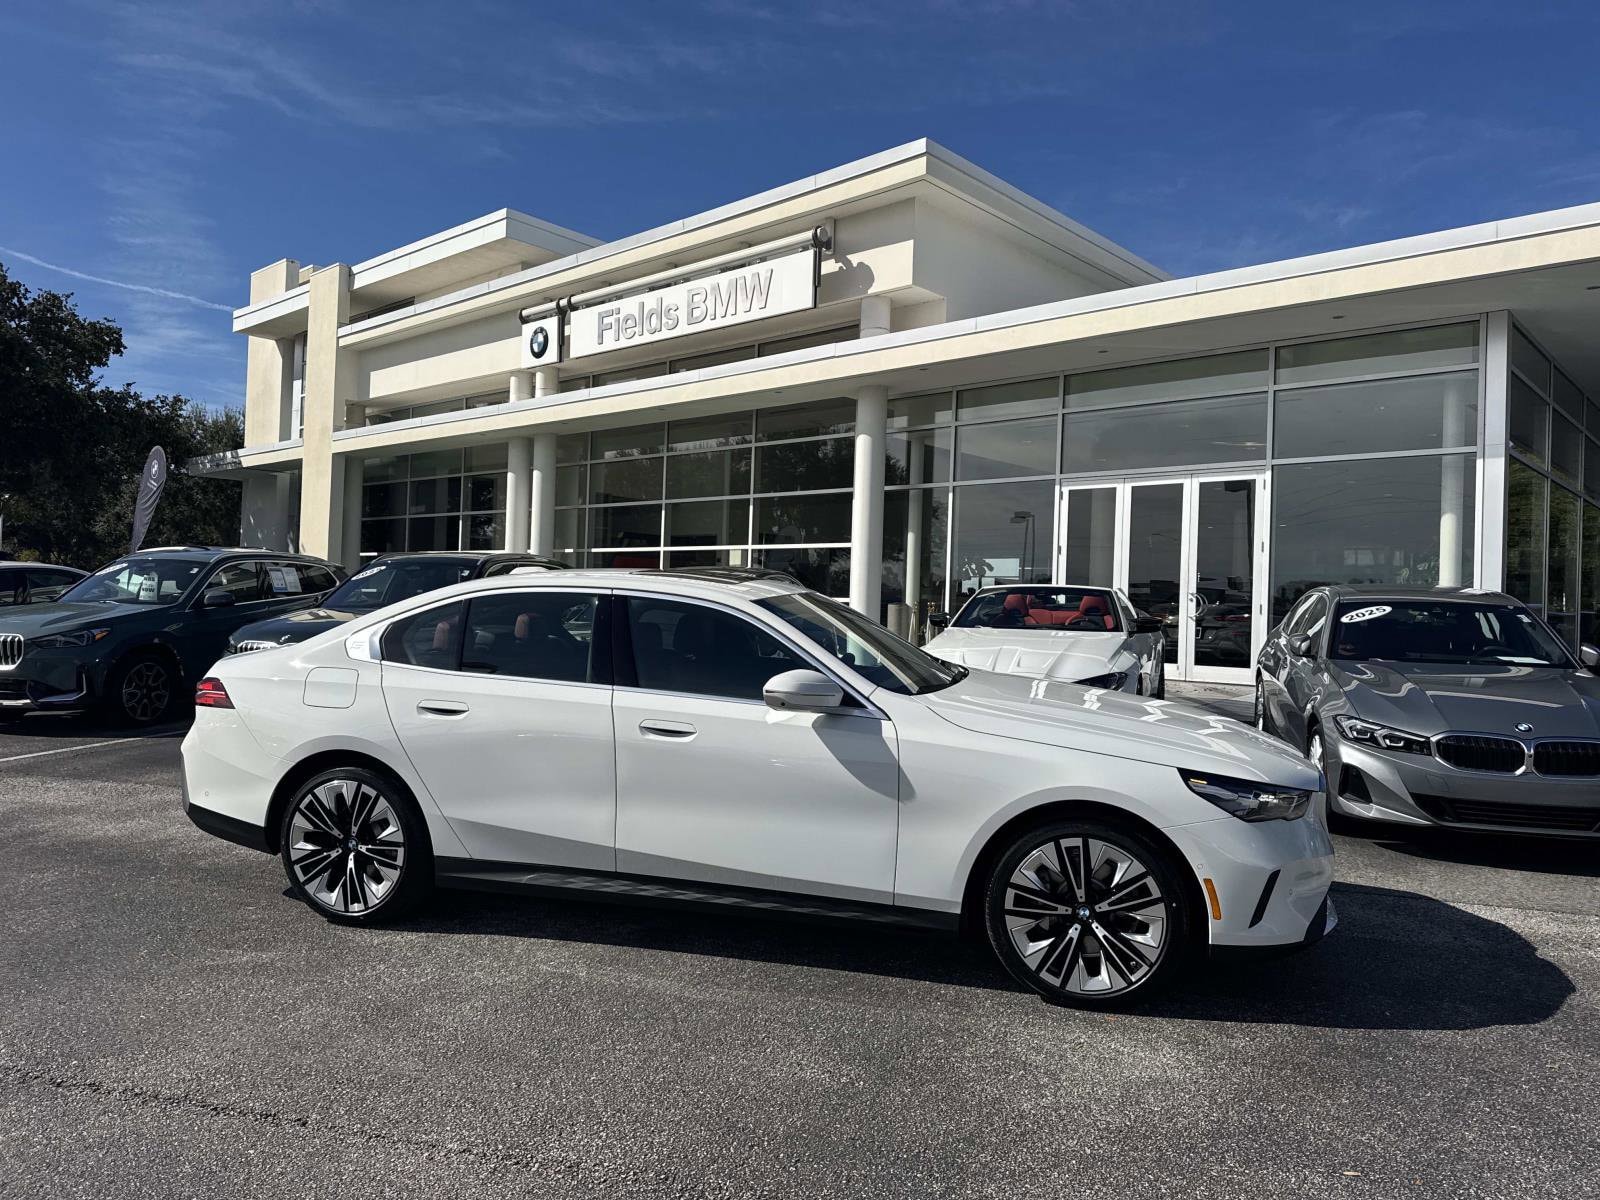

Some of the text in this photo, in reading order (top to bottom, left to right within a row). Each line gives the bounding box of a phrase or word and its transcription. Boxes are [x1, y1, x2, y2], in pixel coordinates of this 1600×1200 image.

[597, 267, 774, 345] Fields BMW
[1345, 606, 1387, 622] 2025
